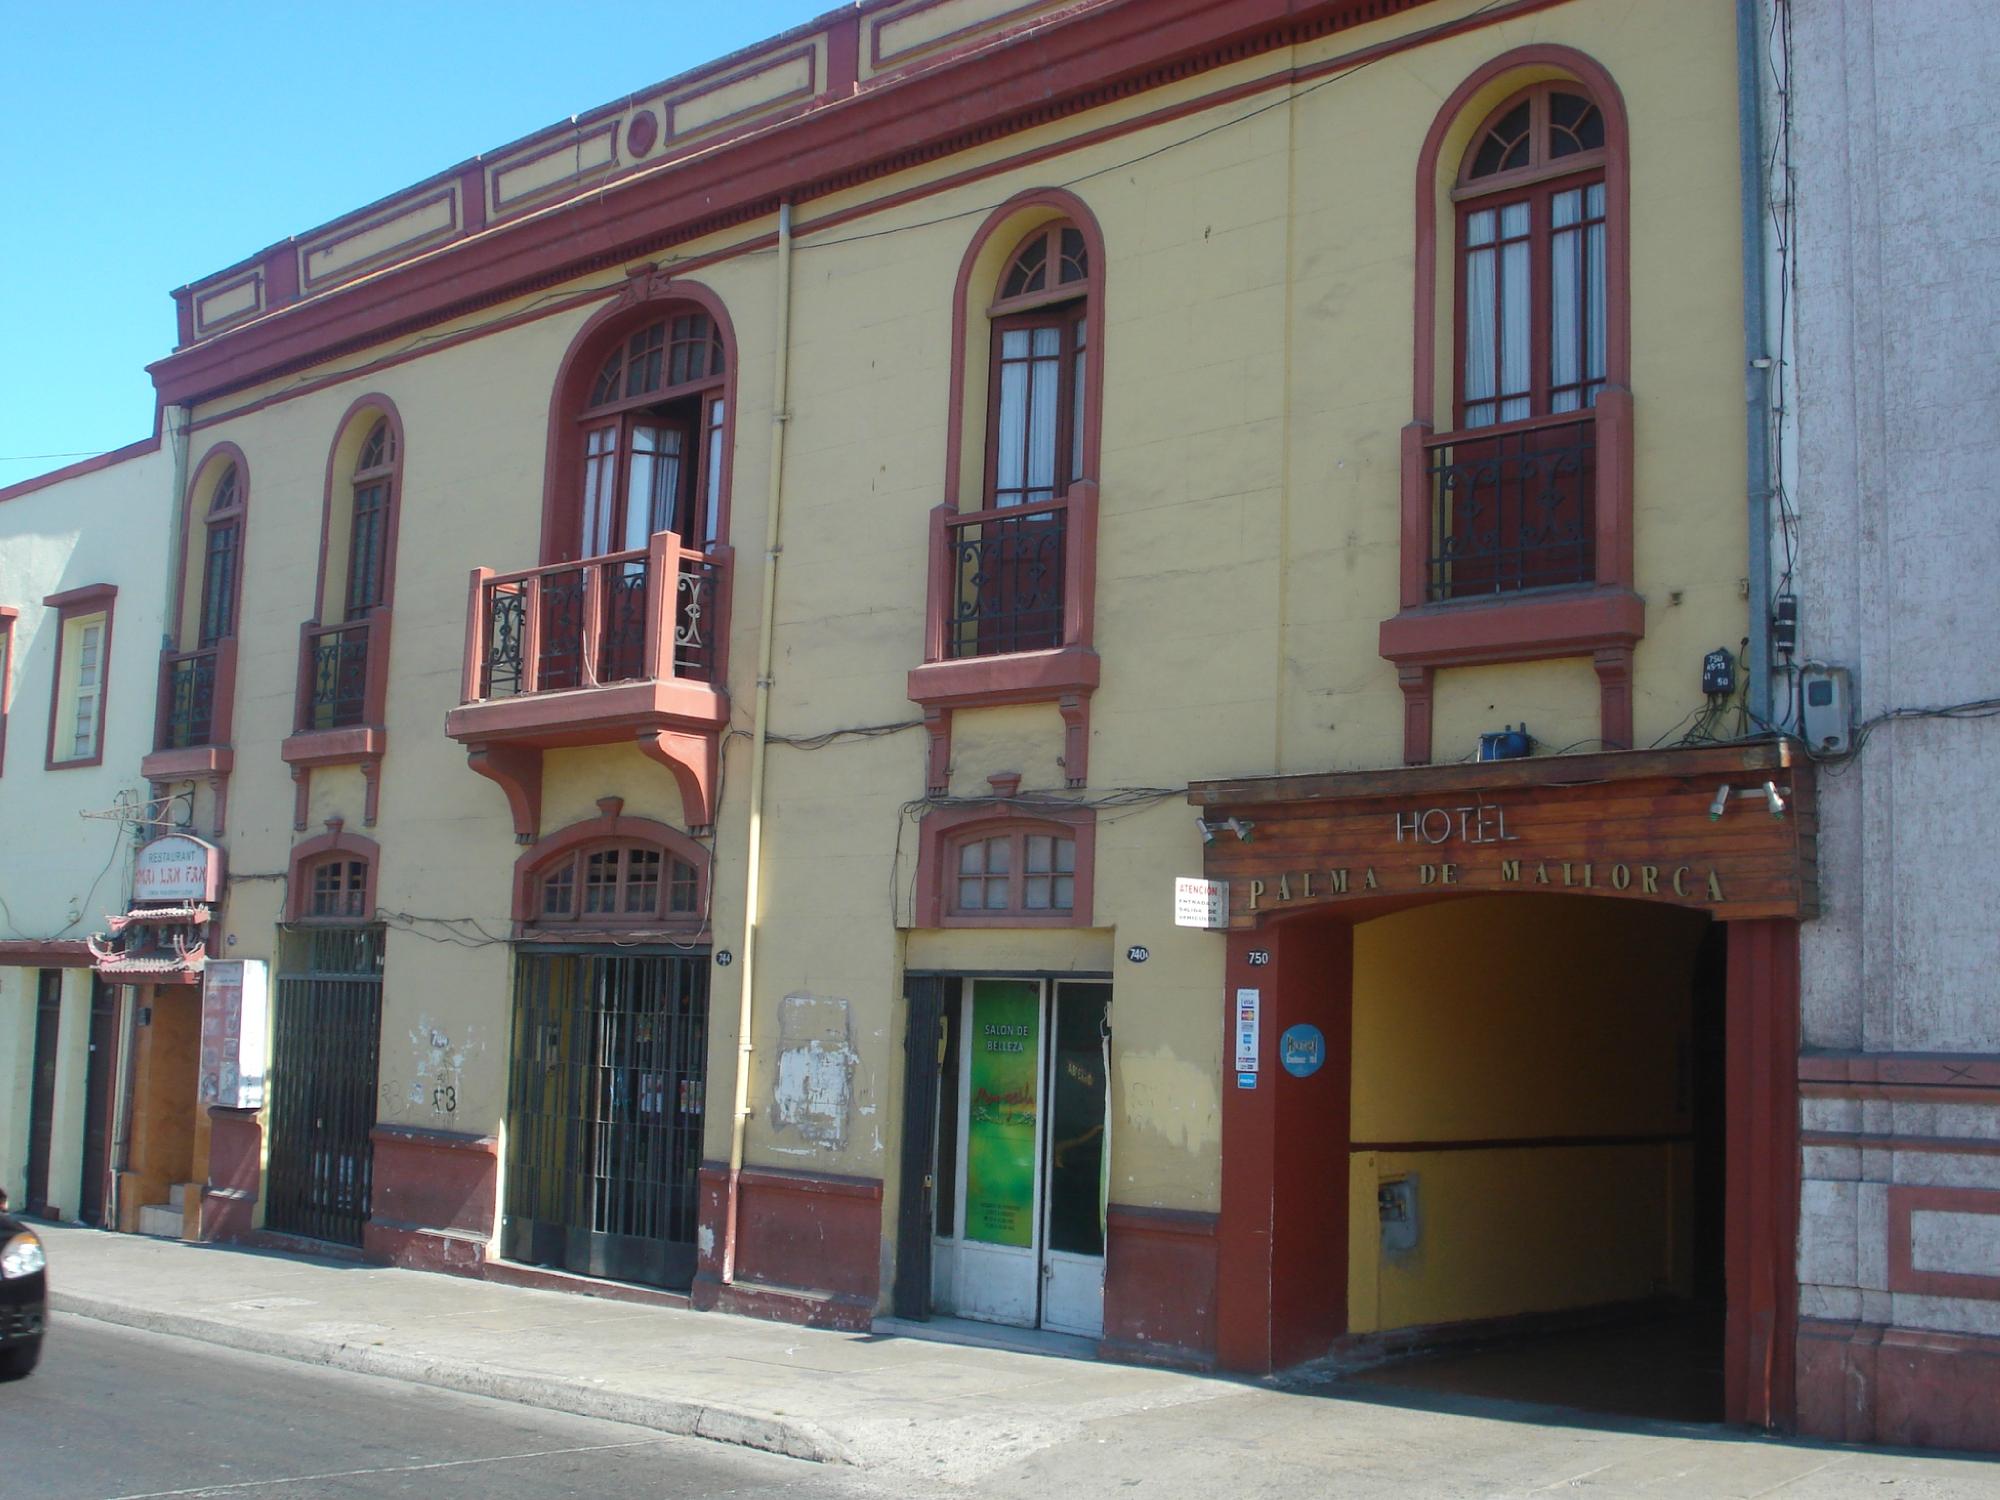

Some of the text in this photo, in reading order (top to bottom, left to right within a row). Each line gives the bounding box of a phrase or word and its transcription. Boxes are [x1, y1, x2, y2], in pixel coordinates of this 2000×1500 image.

[1396, 805, 1520, 844] HOTEL
[149, 850, 195, 864] RESTAURANT
[1250, 860, 1726, 910] PALMA DE MALLORCA
[1249, 952, 1269, 965] 750
[985, 1024, 1029, 1037] SALON DE
[987, 1041, 1024, 1053] BELLEZA
